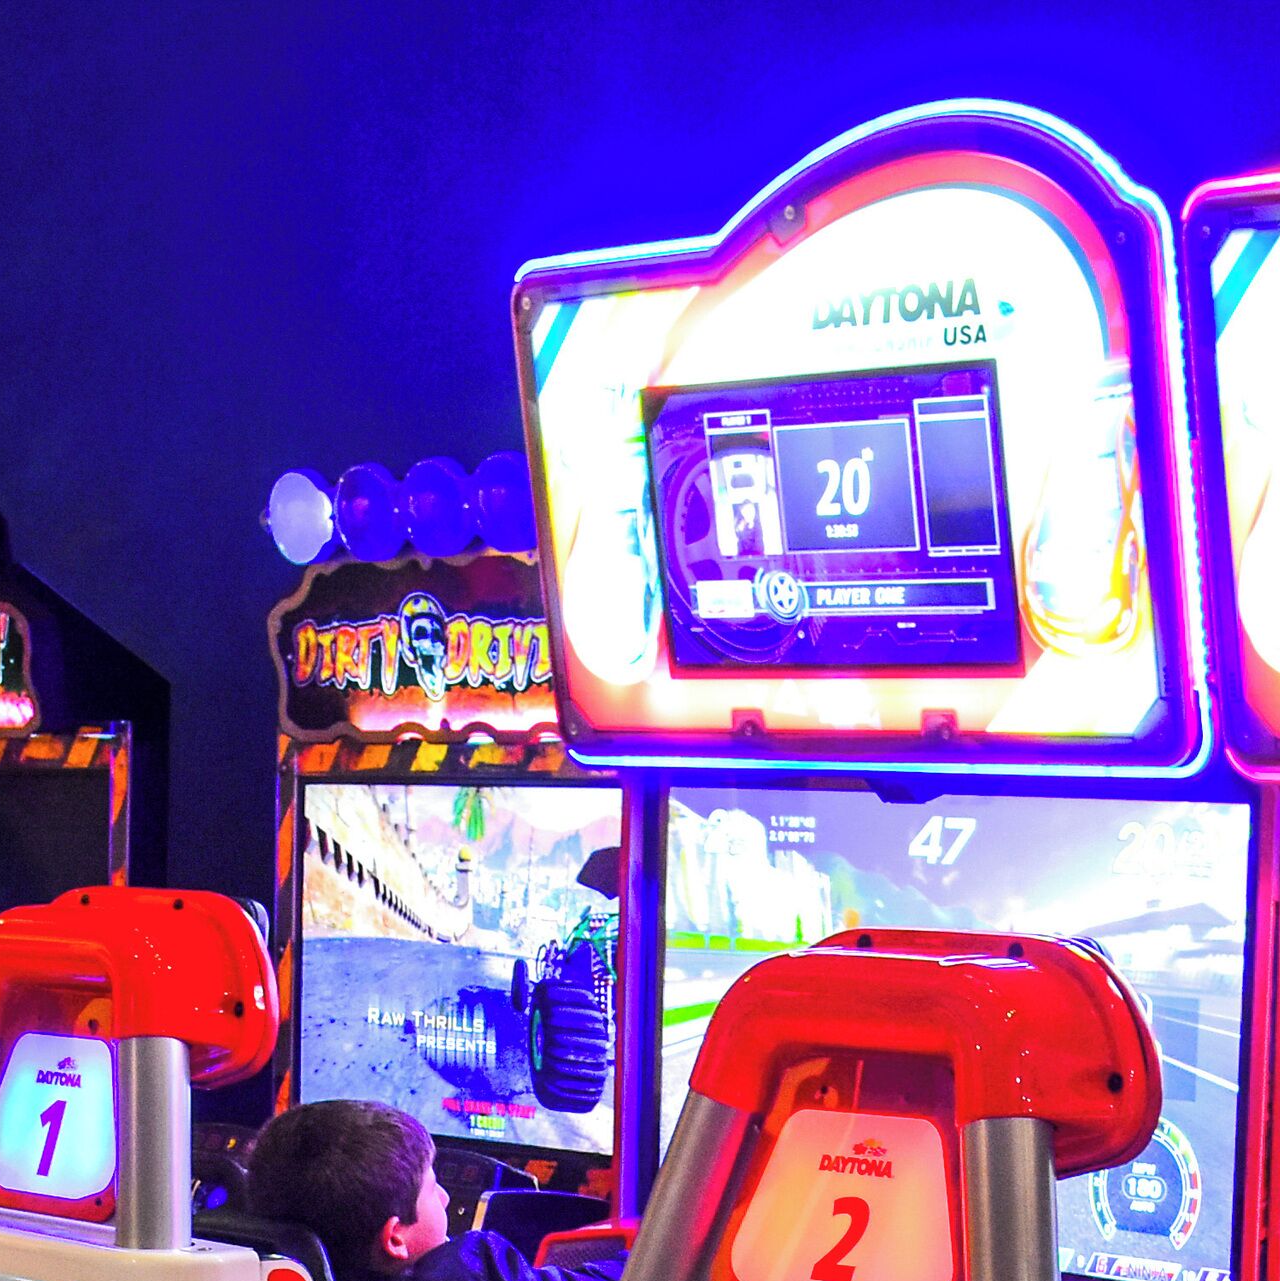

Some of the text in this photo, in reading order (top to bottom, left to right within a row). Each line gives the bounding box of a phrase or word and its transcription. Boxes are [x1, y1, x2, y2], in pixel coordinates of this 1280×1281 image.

[811, 278, 981, 330] DAYTONA
[943, 324, 987, 346] USA
[816, 586, 906, 606] PLAYER ONE
[294, 614, 401, 695] DIRTY
[907, 815, 977, 865] 47
[411, 1011, 485, 1034] THRILLS
[415, 1035, 497, 1055] PRESENTS
[35, 1070, 83, 1089] DAYTONA
[36, 1099, 68, 1177] 1
[818, 1154, 894, 1179] DAYTONA
